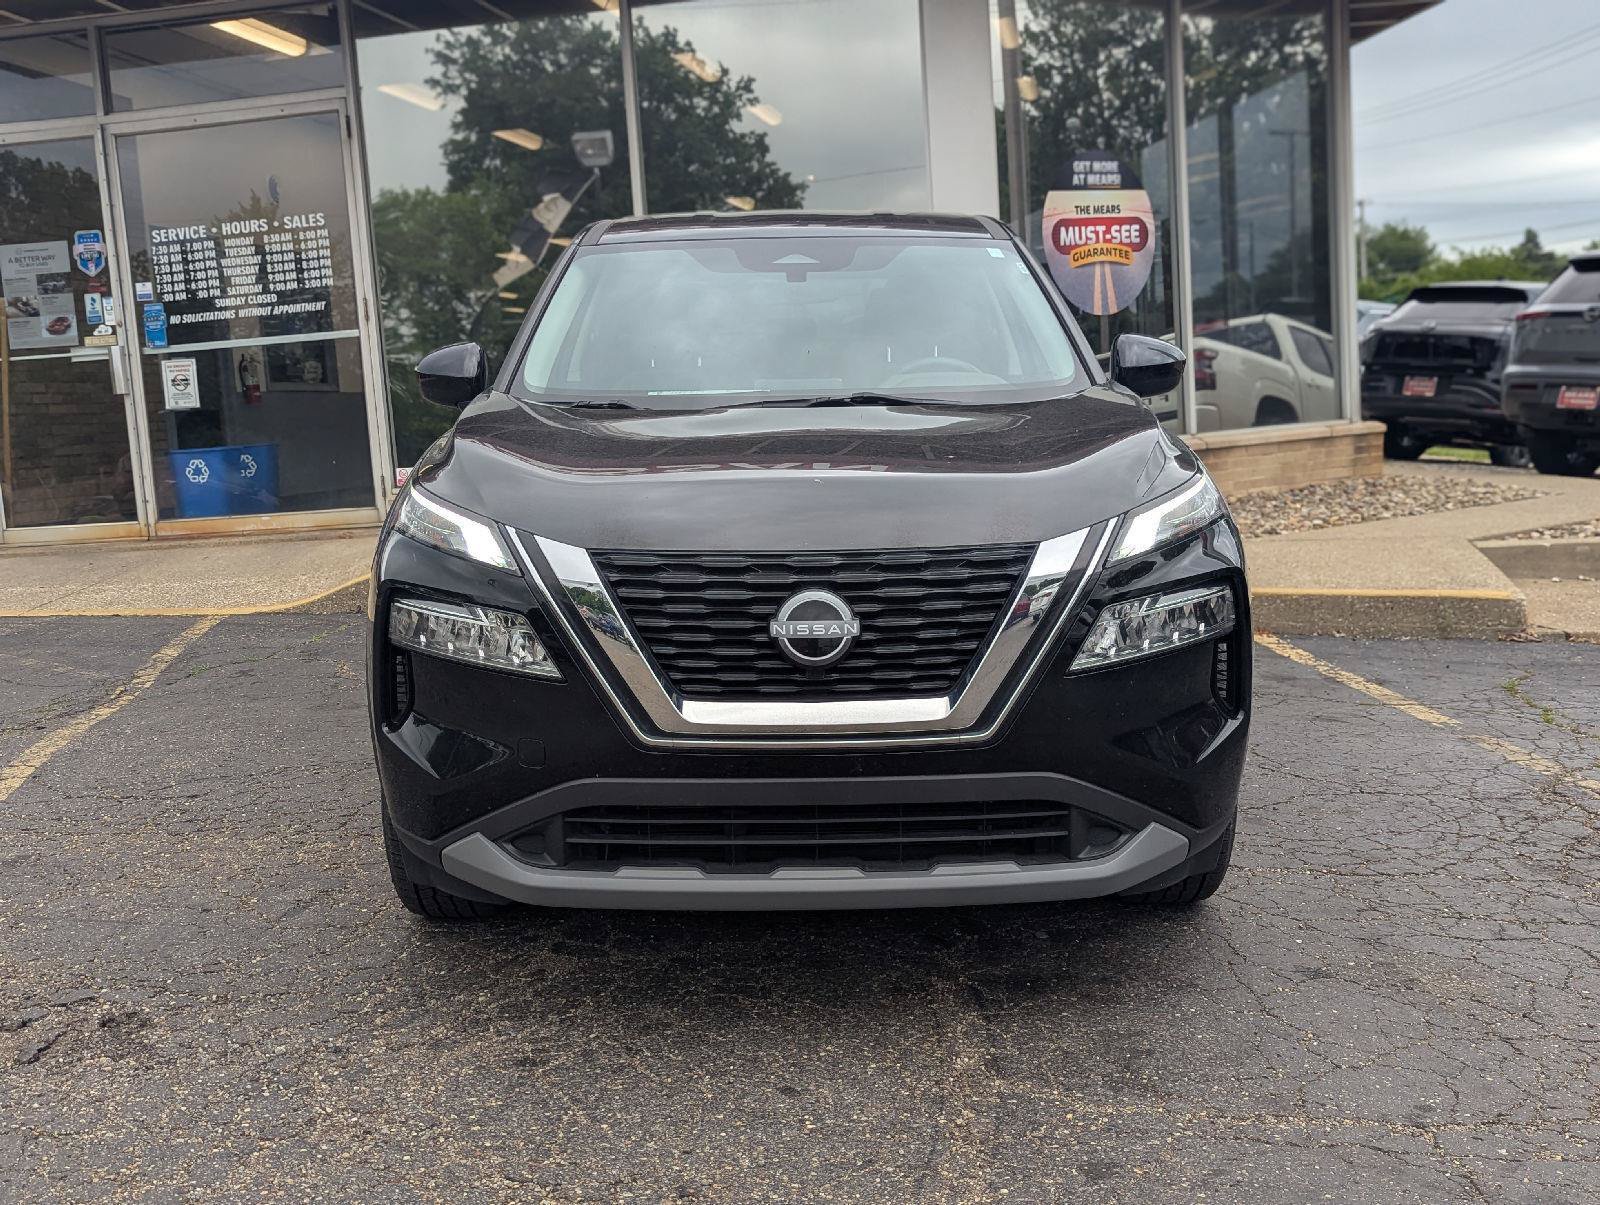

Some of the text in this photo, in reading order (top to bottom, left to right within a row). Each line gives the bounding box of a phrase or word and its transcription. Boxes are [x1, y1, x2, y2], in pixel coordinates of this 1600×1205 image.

[1073, 160, 1091, 173] GET
[1072, 174, 1086, 186] AT
[1074, 204, 1121, 216] THE MEARS
[152, 213, 325, 243] SERVICE HOURS SALES
[1060, 224, 1140, 246] MUST-SEE
[152, 245, 168, 255] 7:30
[169, 243, 181, 253] AM
[203, 240, 215, 249] PM
[224, 236, 254, 247] MONDAY
[263, 234, 280, 243] 8:30
[281, 232, 292, 242] AM
[299, 231, 316, 240] 8:00
[317, 229, 329, 238] PM
[152, 255, 169, 264] 7:30
[170, 254, 182, 262] AM
[187, 252, 203, 261] 6:00
[204, 250, 216, 259] PM
[224, 246, 256, 257] TUESDAY
[265, 244, 281, 253] 9:00
[282, 242, 294, 251] AM
[300, 240, 317, 250] 6:00
[318, 238, 330, 248] PM
[154, 265, 170, 274] 7:30
[172, 263, 184, 272] AM
[189, 261, 205, 271] 6:00
[206, 260, 217, 269] PM
[220, 255, 262, 267] WEDNESDAY
[266, 253, 282, 262] 9:00
[283, 252, 295, 261] AM
[301, 250, 318, 259] 6:00
[319, 249, 331, 258] PM
[1072, 248, 1130, 262] GUARANTEE
[156, 274, 172, 283] 7:30
[173, 272, 185, 282] AM
[190, 271, 206, 280] 7:00
[207, 269, 219, 278] PM
[223, 265, 260, 277] THURSDAY
[266, 263, 283, 272] 8:30
[284, 261, 295, 271] AM
[302, 260, 319, 269] 8:00
[320, 258, 331, 267] PM
[156, 284, 172, 293] 7:30
[174, 282, 186, 291] AM
[191, 280, 207, 290] 6:00
[208, 279, 220, 288] PM
[231, 274, 256, 286] FRIDAY
[268, 273, 284, 282] 9:00
[285, 271, 297, 280] AM
[304, 269, 320, 278] 6:00
[321, 268, 333, 277] PM
[175, 292, 187, 301] AM
[210, 288, 221, 297] PM
[226, 283, 263, 296] SATURDAY
[269, 282, 285, 292] 9:00
[286, 281, 298, 290] AM
[304, 279, 321, 288] 3:00
[322, 277, 334, 286] PM
[215, 294, 278, 308] SUNDAY CLOSED
[169, 314, 181, 325] NO
[182, 309, 236, 324] SOLICITATIONS
[238, 306, 272, 318] WITHOUT
[272, 300, 327, 315] APPOINTMENT
[773, 623, 857, 635] NISSAN
